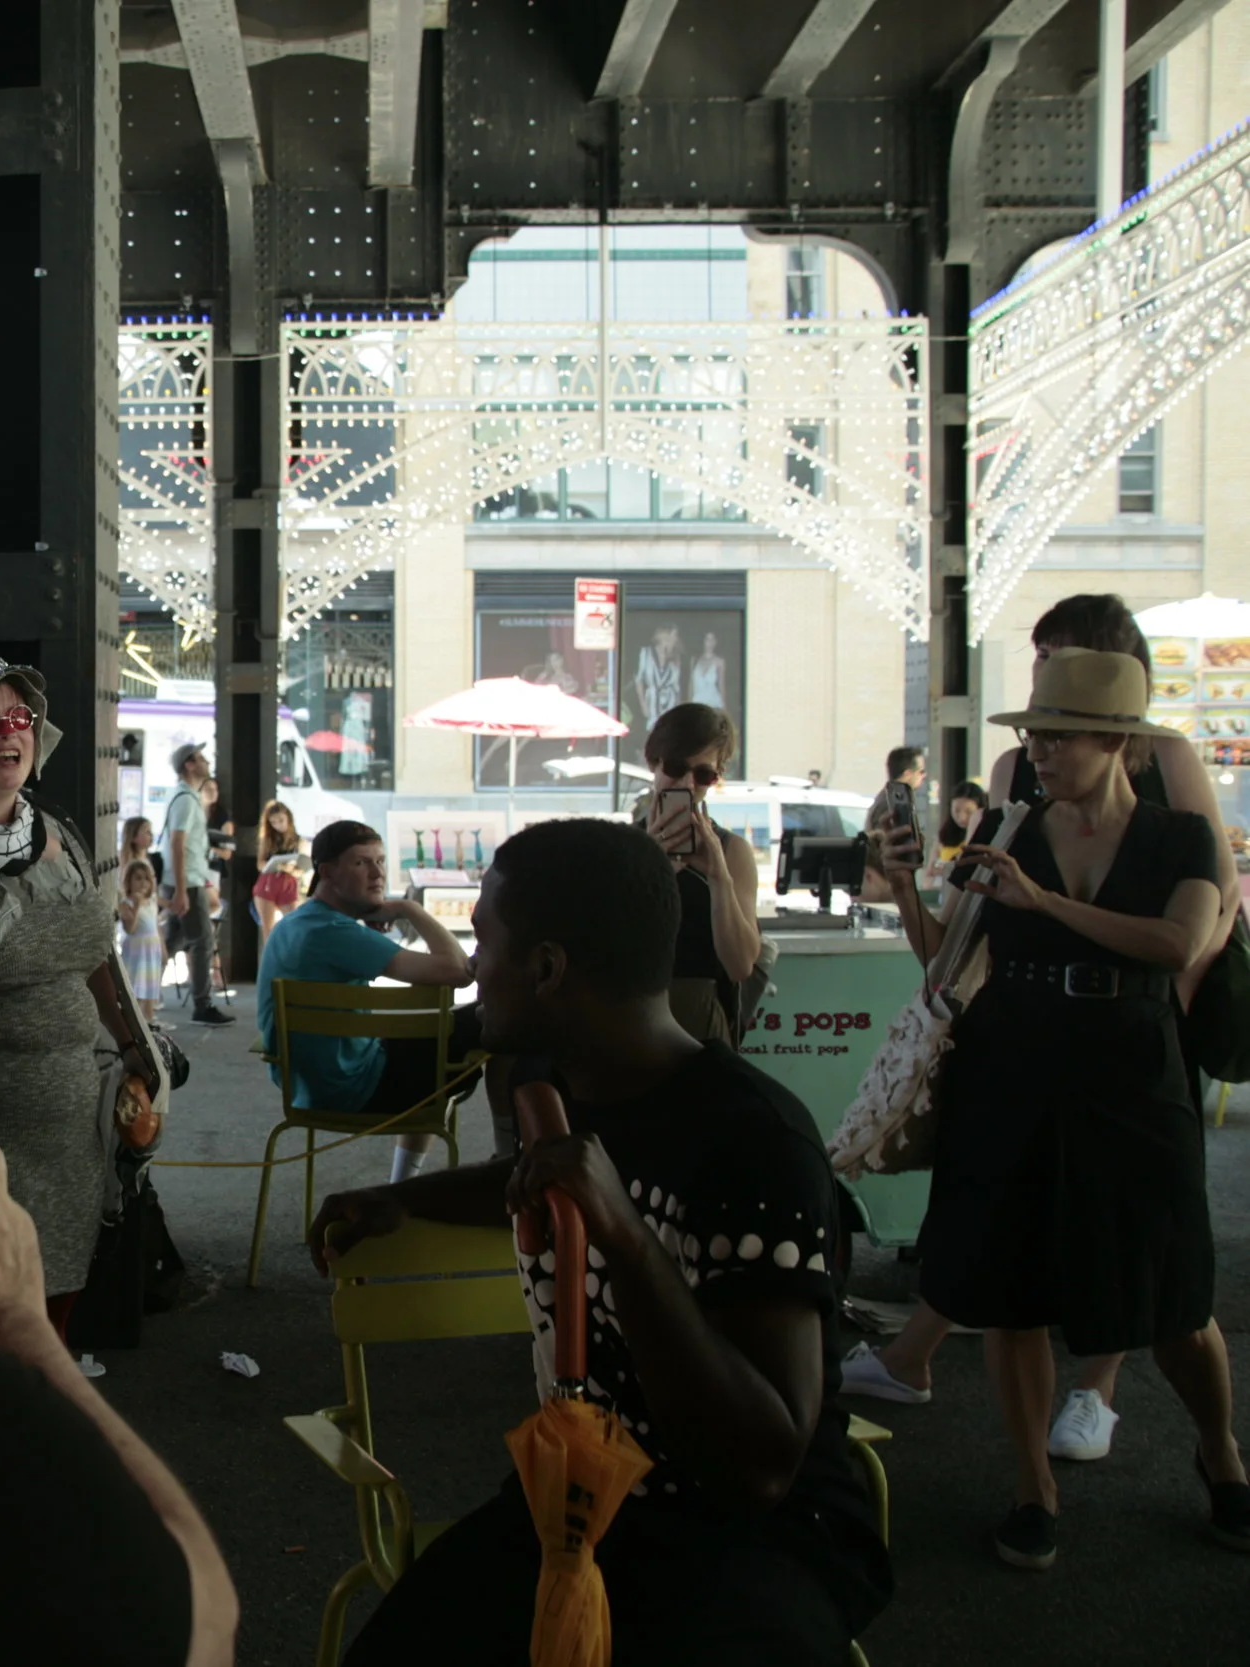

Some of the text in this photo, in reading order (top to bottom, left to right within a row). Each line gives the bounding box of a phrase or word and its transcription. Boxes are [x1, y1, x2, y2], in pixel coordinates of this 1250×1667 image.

[793, 1012, 872, 1036] pops
[738, 1044, 848, 1056] ocal fruit pops
